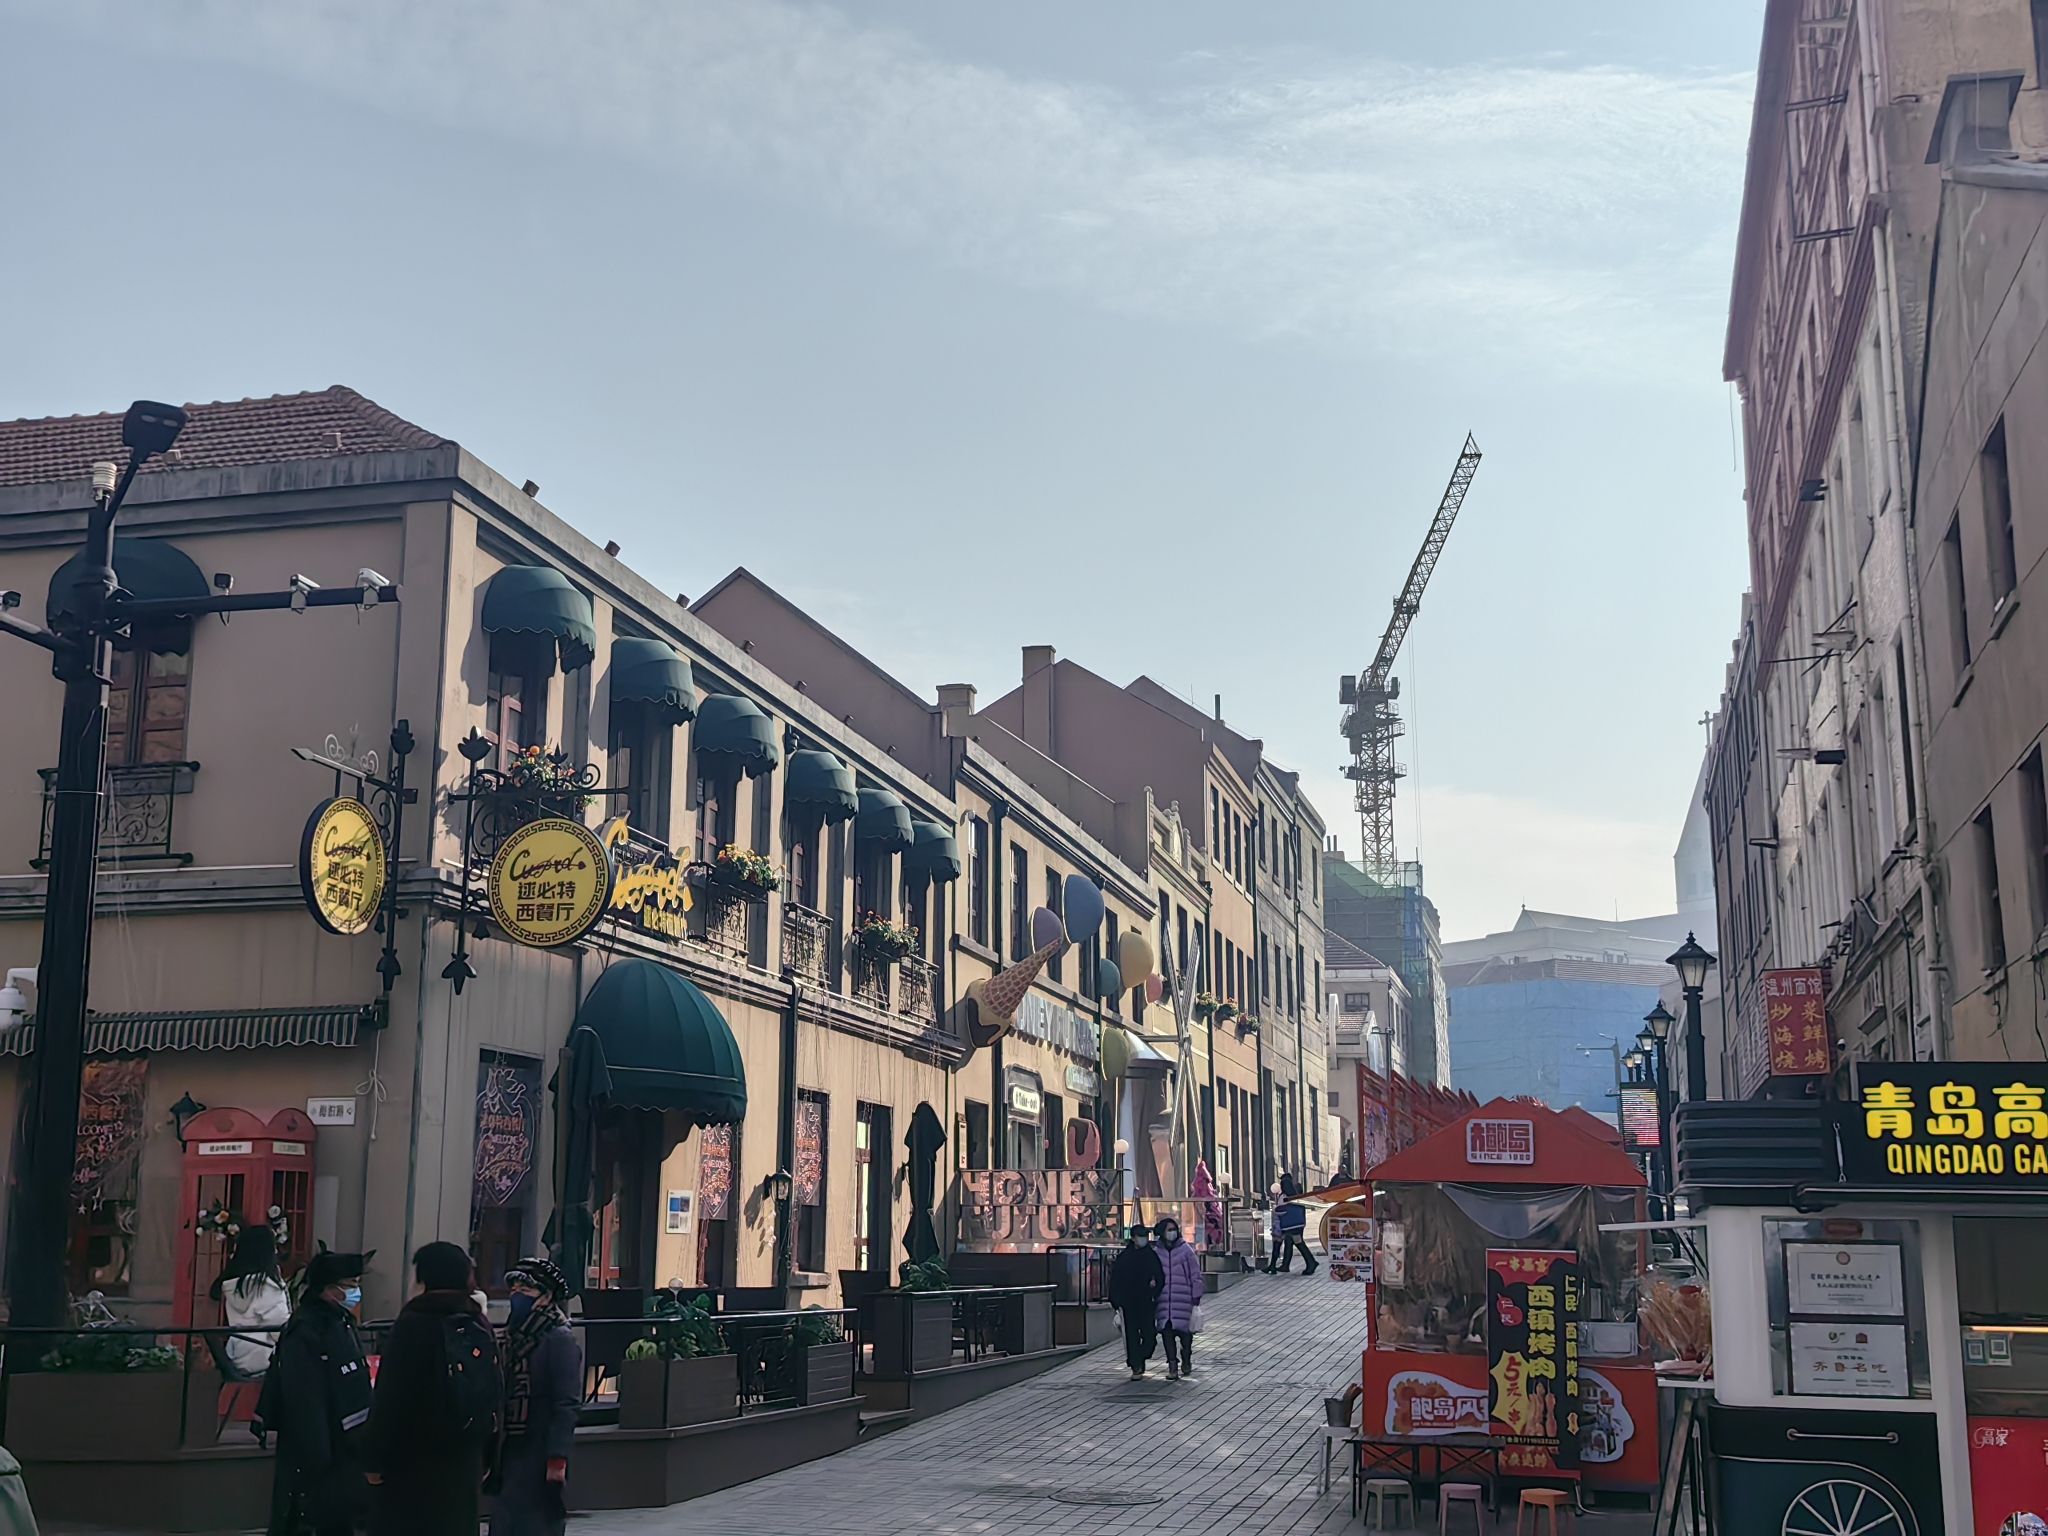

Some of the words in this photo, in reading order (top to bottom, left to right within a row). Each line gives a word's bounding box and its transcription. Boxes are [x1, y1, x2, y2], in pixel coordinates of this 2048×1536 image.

[326, 881, 363, 911] 西餐厅
[516, 903, 576, 922] 西餐厅
[1766, 976, 1822, 996] 温州面馆
[1770, 999, 1824, 1022] 炒菜
[1774, 1023, 1824, 1046] 海鲜
[1775, 1047, 1826, 1069] 烧烤
[1861, 1081, 2048, 1139] 青岛高
[1887, 1143, 2005, 1175] QINGDAO
[1527, 1285, 1556, 1379] 西镇烤肉
